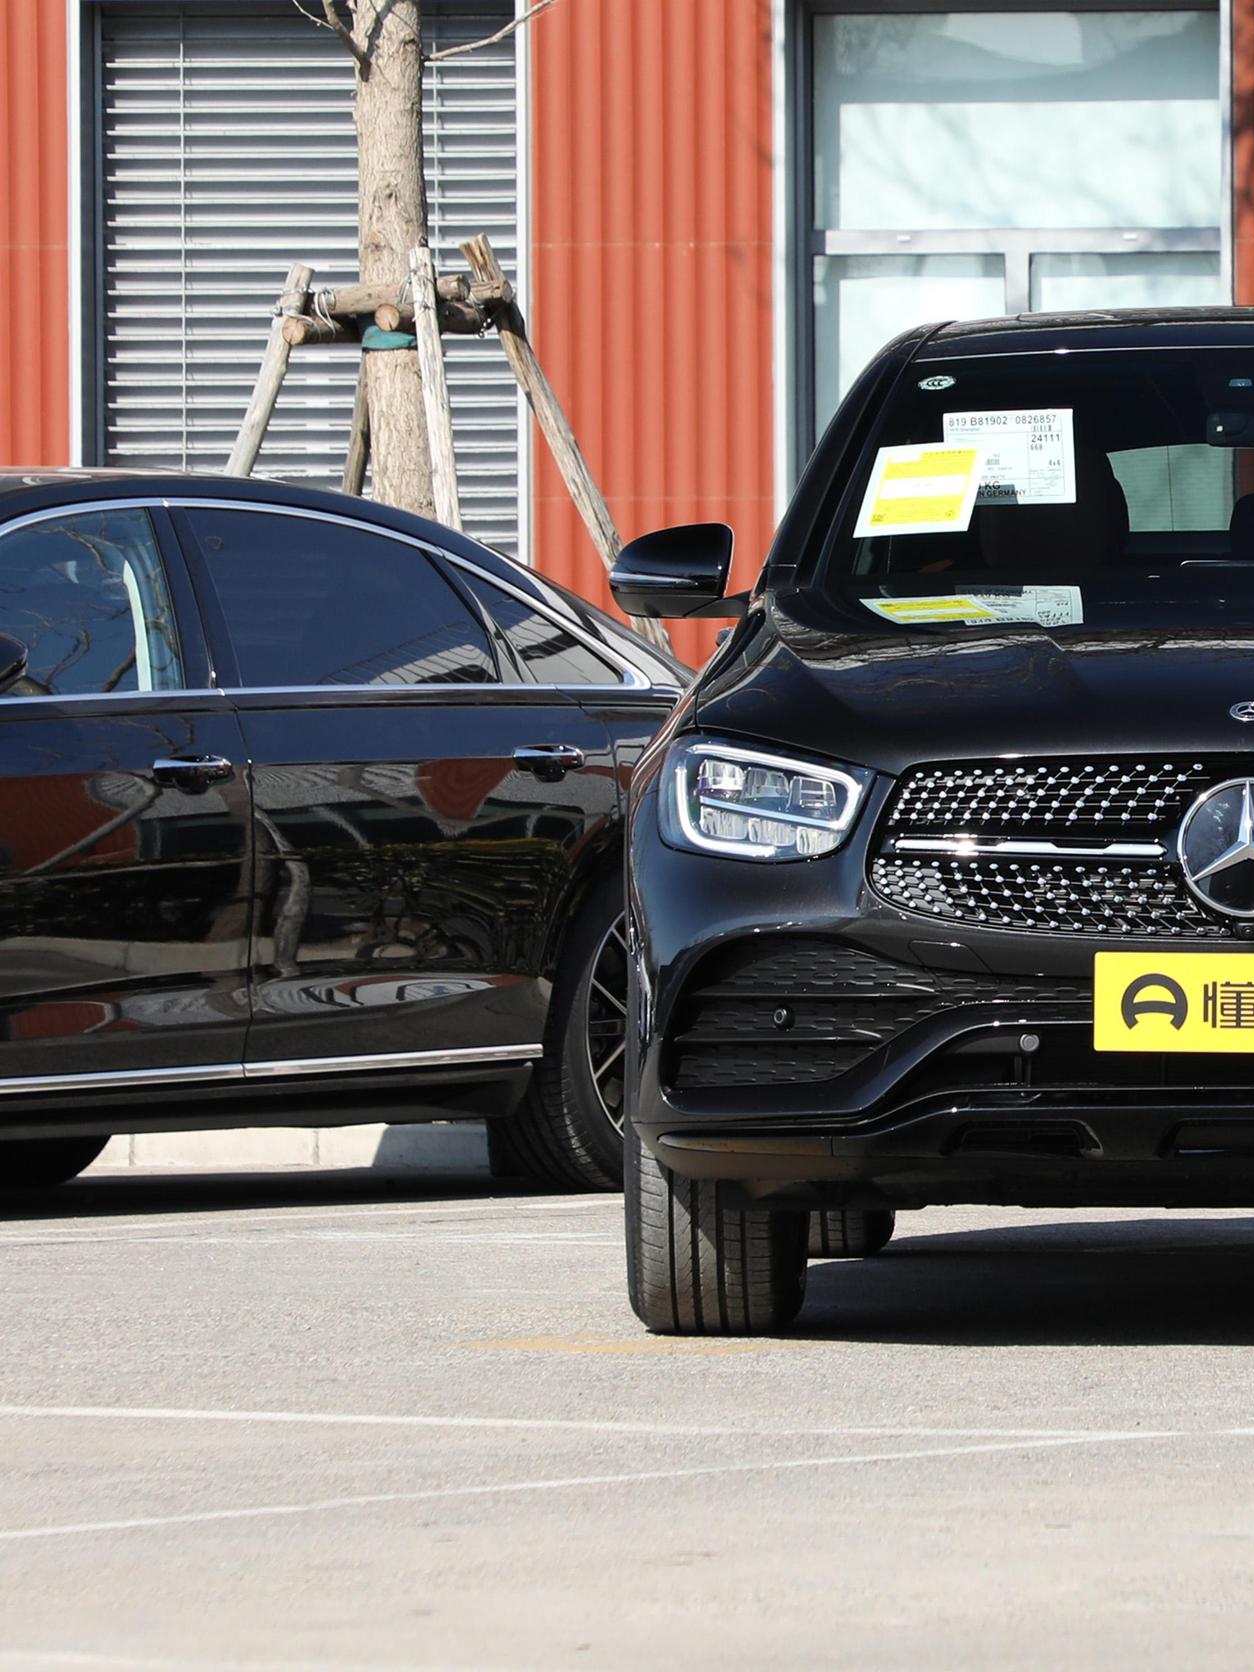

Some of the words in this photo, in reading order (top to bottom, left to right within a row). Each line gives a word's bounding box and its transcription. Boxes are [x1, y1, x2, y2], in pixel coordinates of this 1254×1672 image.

[948, 417, 967, 426] 819
[970, 416, 1008, 426] B81902
[1015, 414, 1057, 424] 0826857
[1031, 433, 1060, 443] 24111
[984, 480, 1001, 490] KG
[986, 487, 1027, 497] GERMANY
